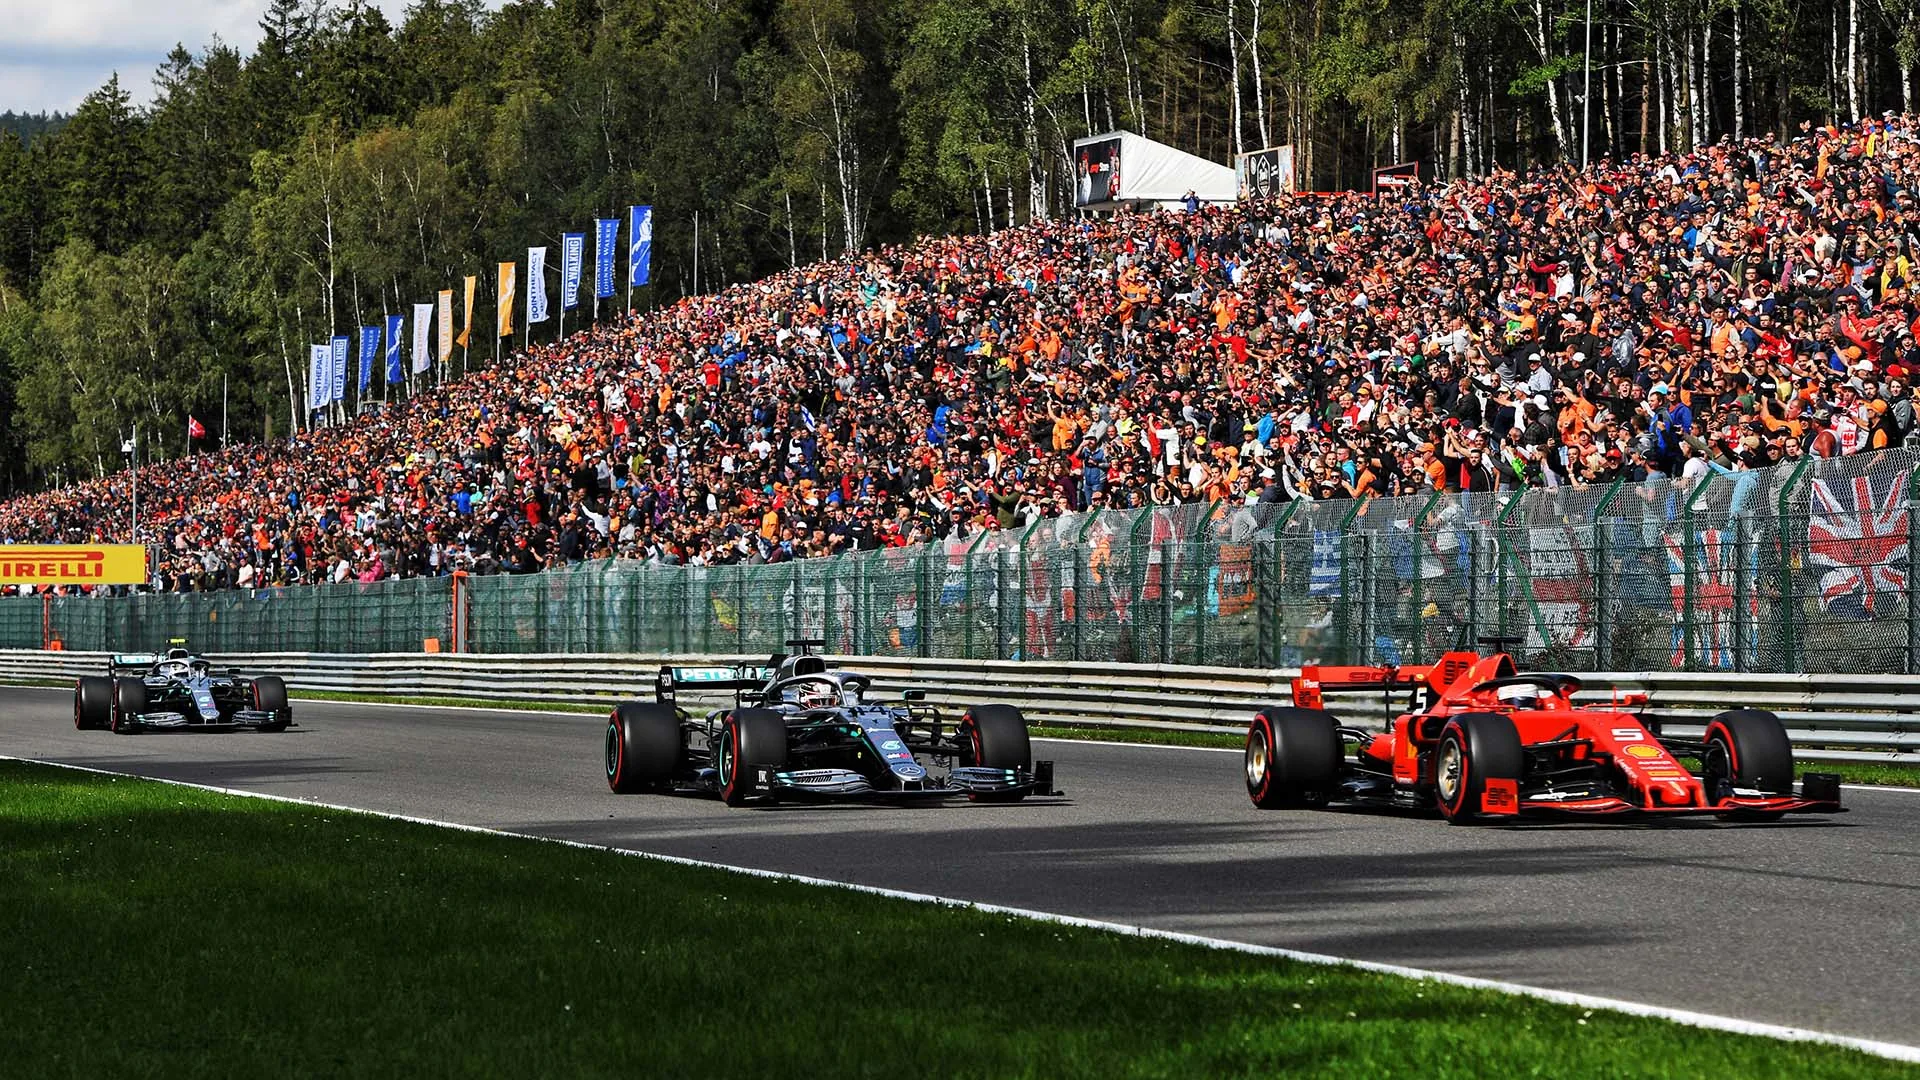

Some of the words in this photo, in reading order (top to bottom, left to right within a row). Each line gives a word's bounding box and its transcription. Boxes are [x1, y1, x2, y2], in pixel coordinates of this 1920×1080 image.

[568, 240, 580, 281] WALKING
[567, 281, 577, 305] KEEP
[0, 551, 104, 577] IRELLI
[1413, 687, 1427, 715] 5
[1611, 728, 1644, 741] 5
